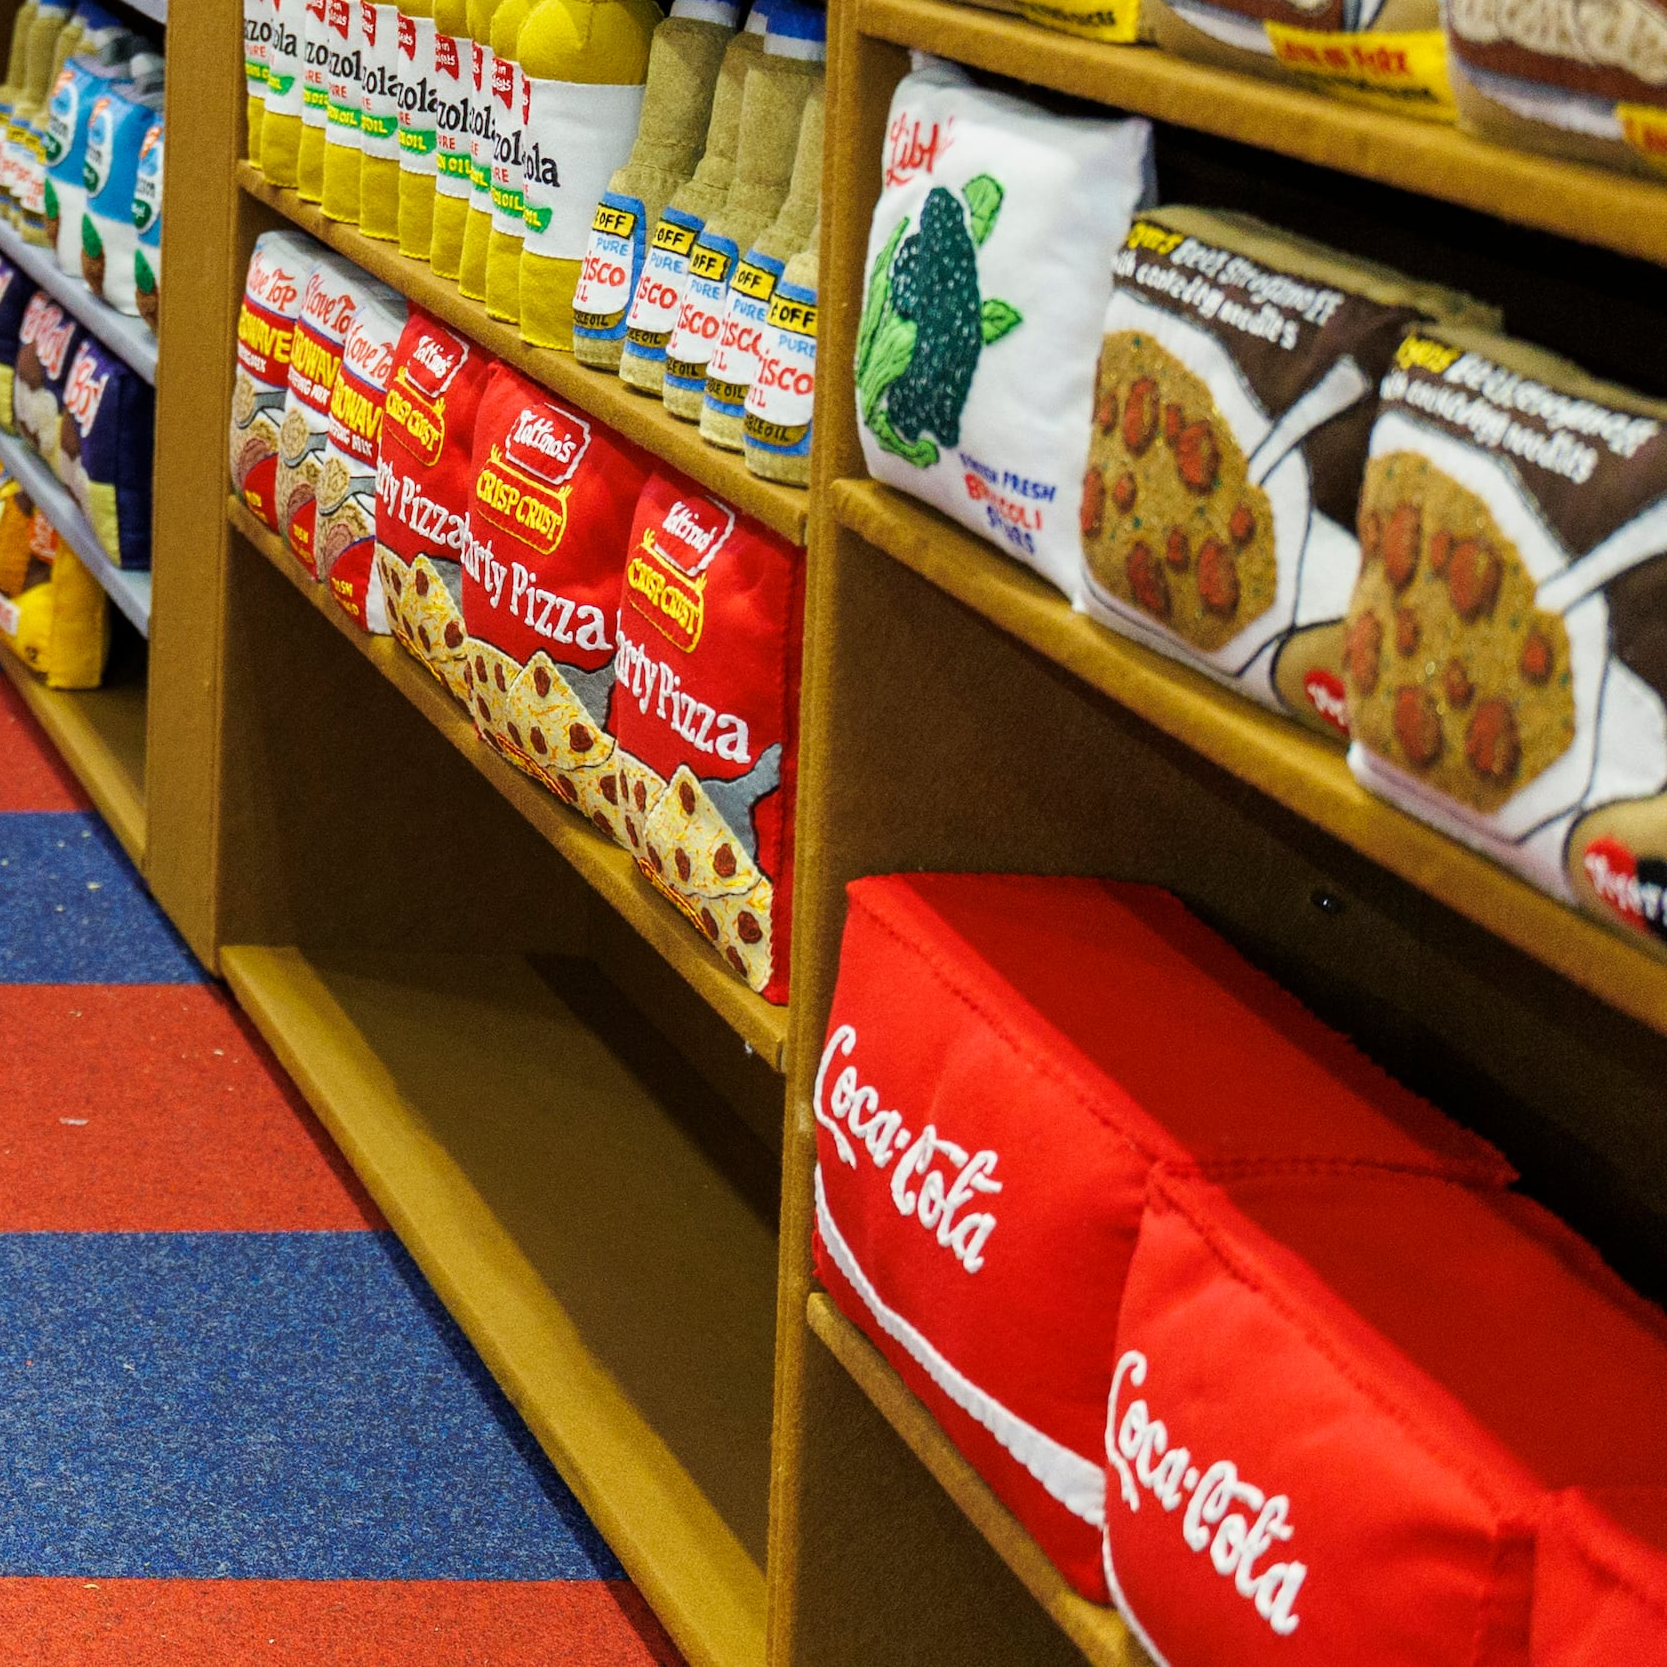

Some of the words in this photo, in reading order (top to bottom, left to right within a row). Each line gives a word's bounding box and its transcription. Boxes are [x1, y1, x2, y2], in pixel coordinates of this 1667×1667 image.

[596, 237, 629, 256] PURE
[599, 212, 627, 230] OFF
[657, 230, 685, 246] OFF
[650, 252, 683, 273] PURE
[779, 306, 816, 327] OFF
[385, 388, 413, 430] CRISP
[411, 410, 440, 454] CRUST
[401, 475, 466, 547] Pizza
[476, 472, 517, 516] CRISP
[516, 498, 563, 543] CRUST
[508, 562, 614, 653] Pizza
[627, 558, 664, 604] CRISP
[661, 584, 703, 637] CRUST
[657, 664, 753, 765] Pizza
[813, 1024, 1003, 1274] Coca-Cola
[1106, 1349, 1309, 1636] Coca-Cola
